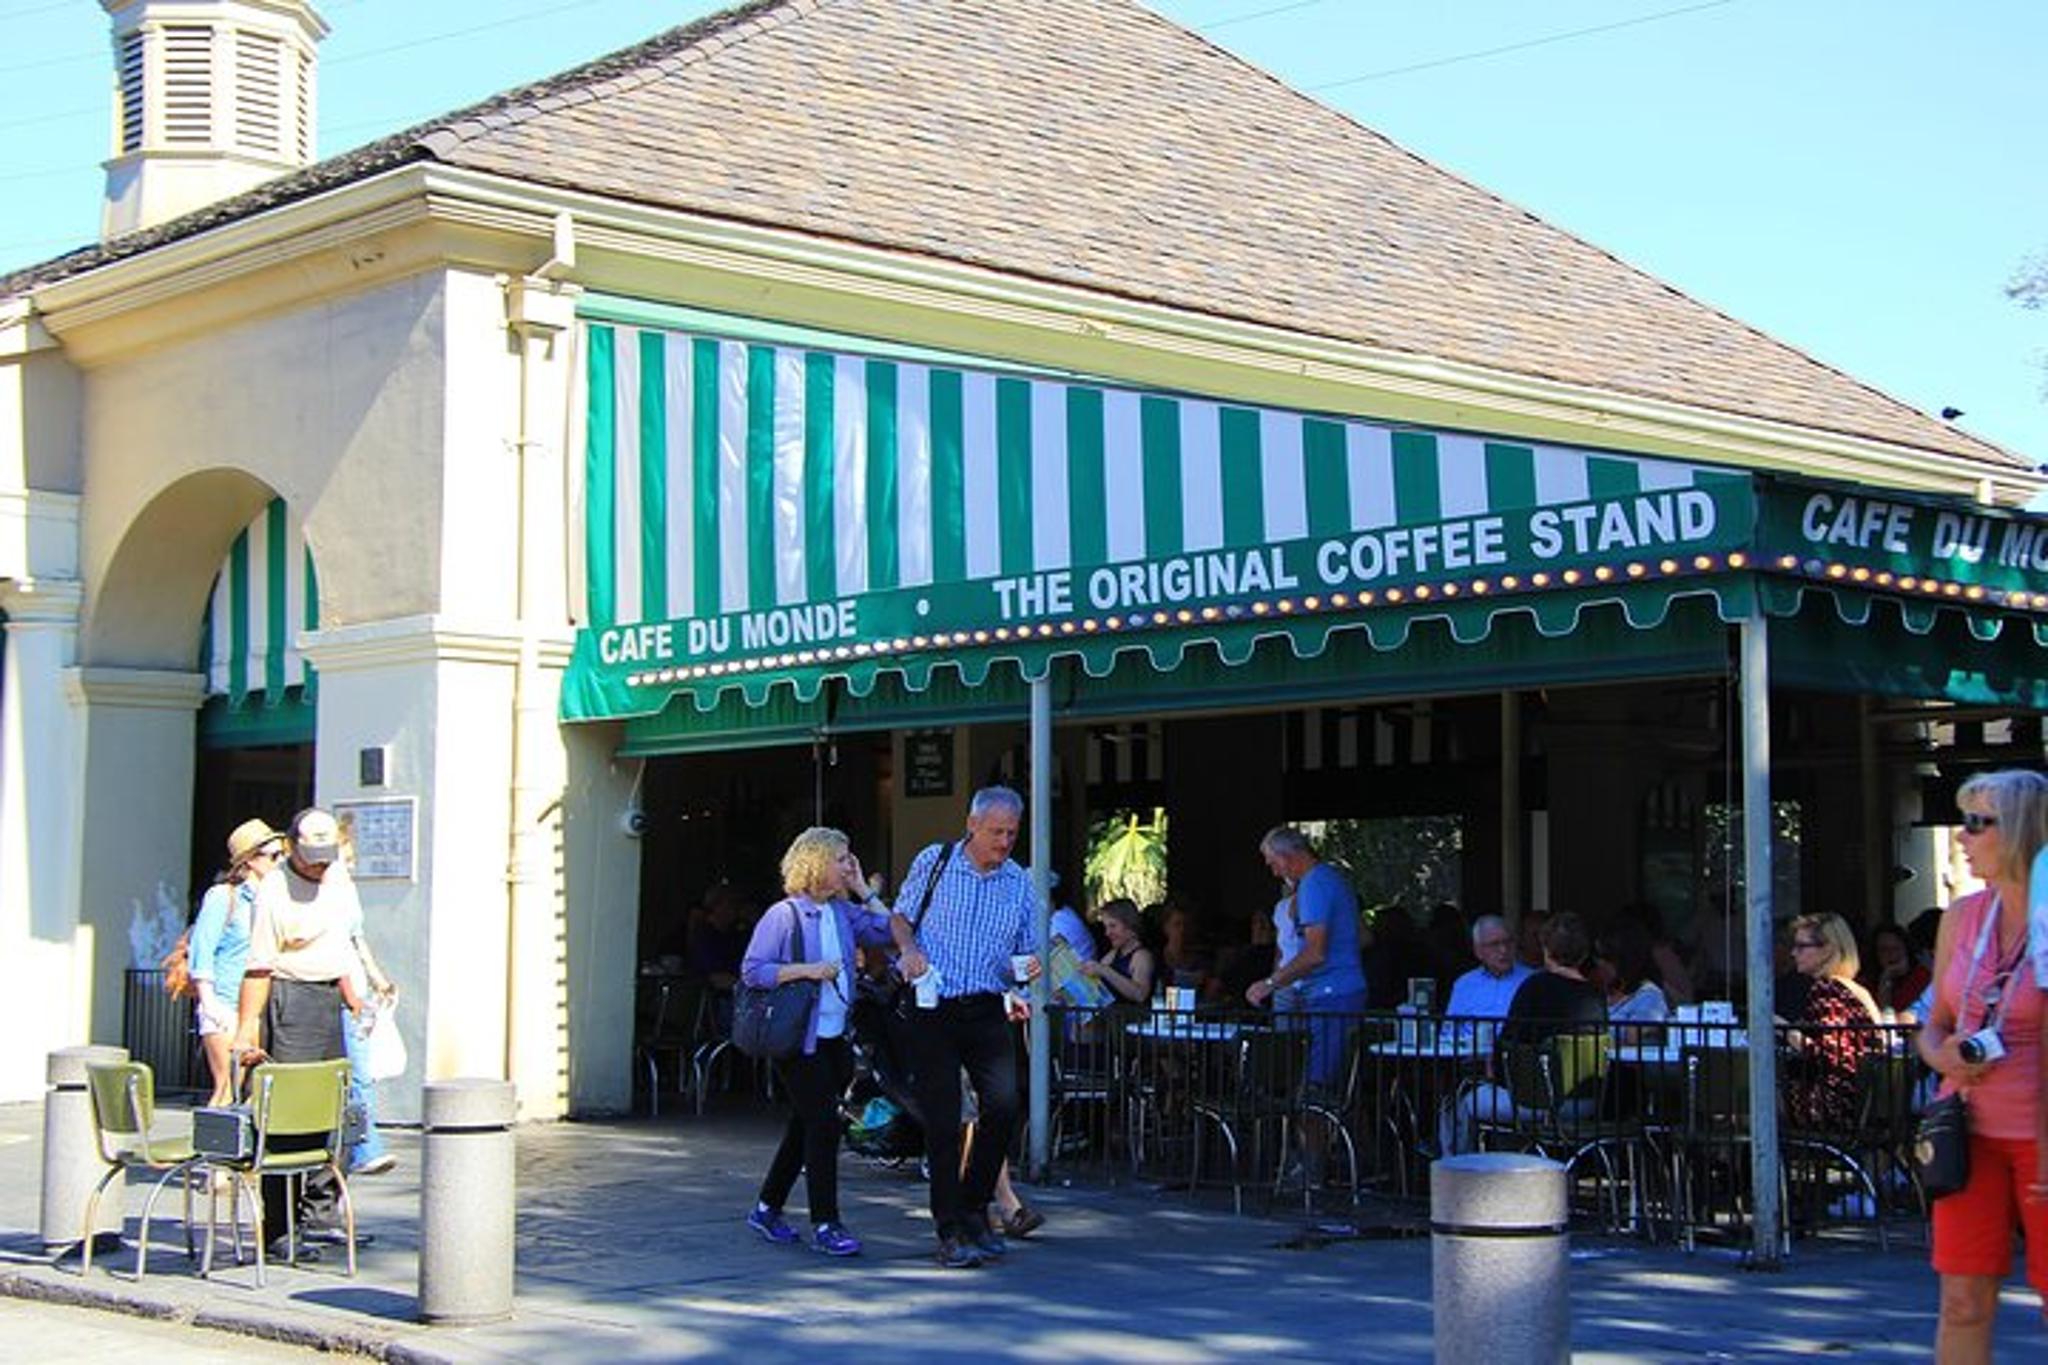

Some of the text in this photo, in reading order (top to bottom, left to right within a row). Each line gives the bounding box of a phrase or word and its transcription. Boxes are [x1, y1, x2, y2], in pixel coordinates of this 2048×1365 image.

[601, 490, 1717, 665] CAFE DU MONDE THE ORIGINAL COFFEE STAND
[1802, 494, 1915, 553] CAFE
[1932, 511, 1991, 564] DU
